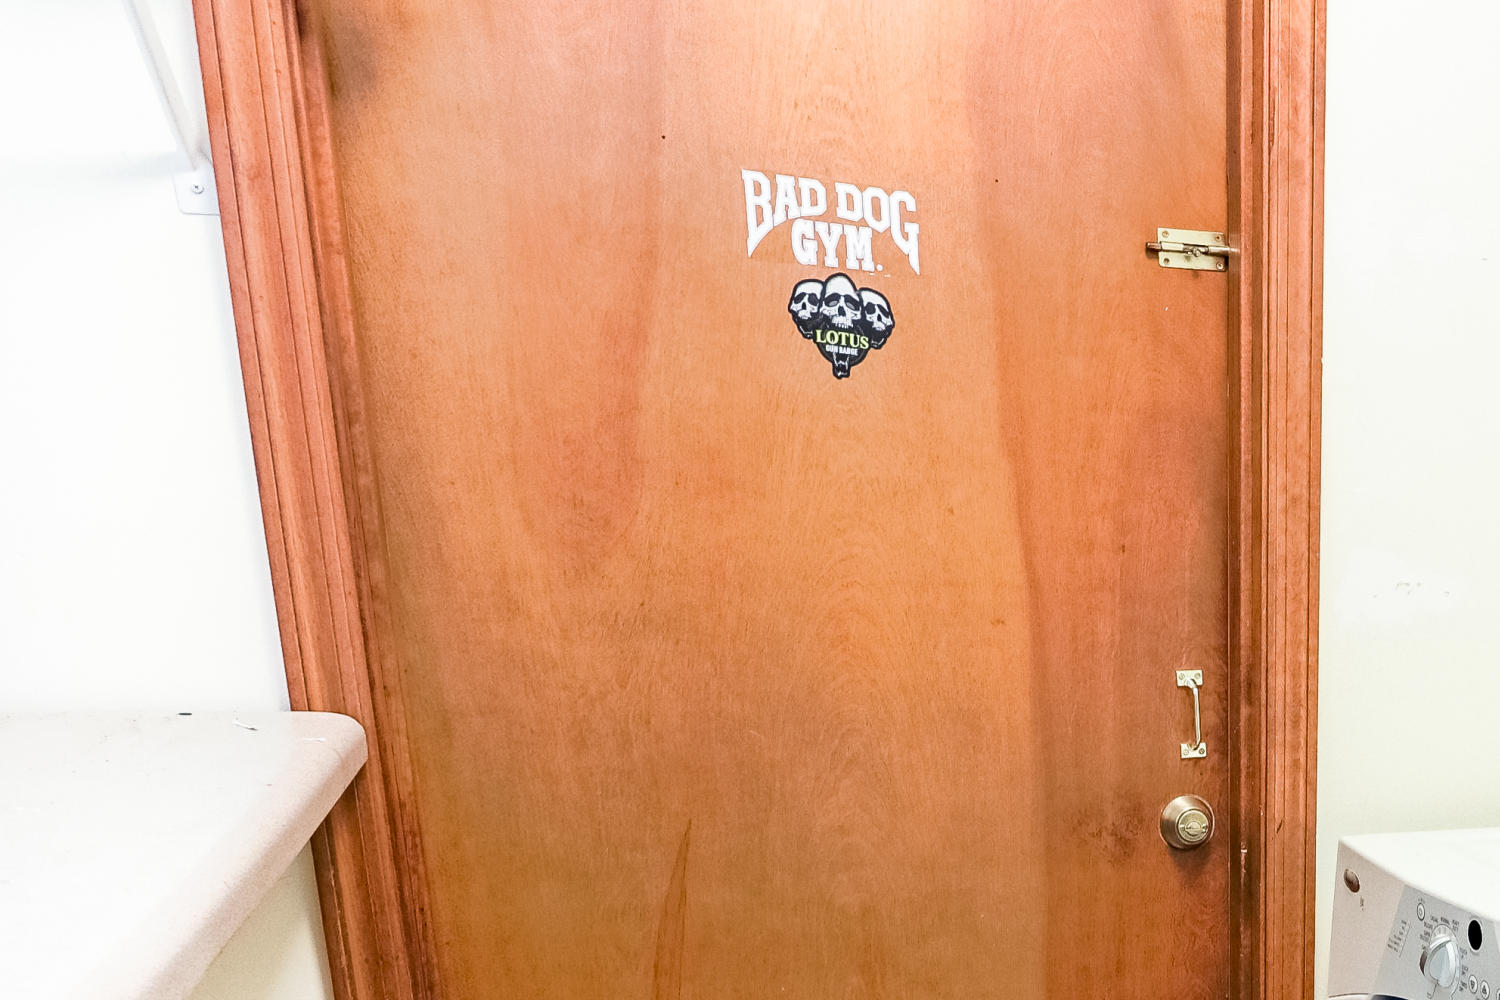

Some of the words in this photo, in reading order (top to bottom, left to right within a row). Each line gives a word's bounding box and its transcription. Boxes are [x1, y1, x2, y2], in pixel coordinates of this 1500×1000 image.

[741, 169, 827, 258] BAD
[835, 182, 920, 275] DOG
[815, 329, 869, 349] LOTUS
